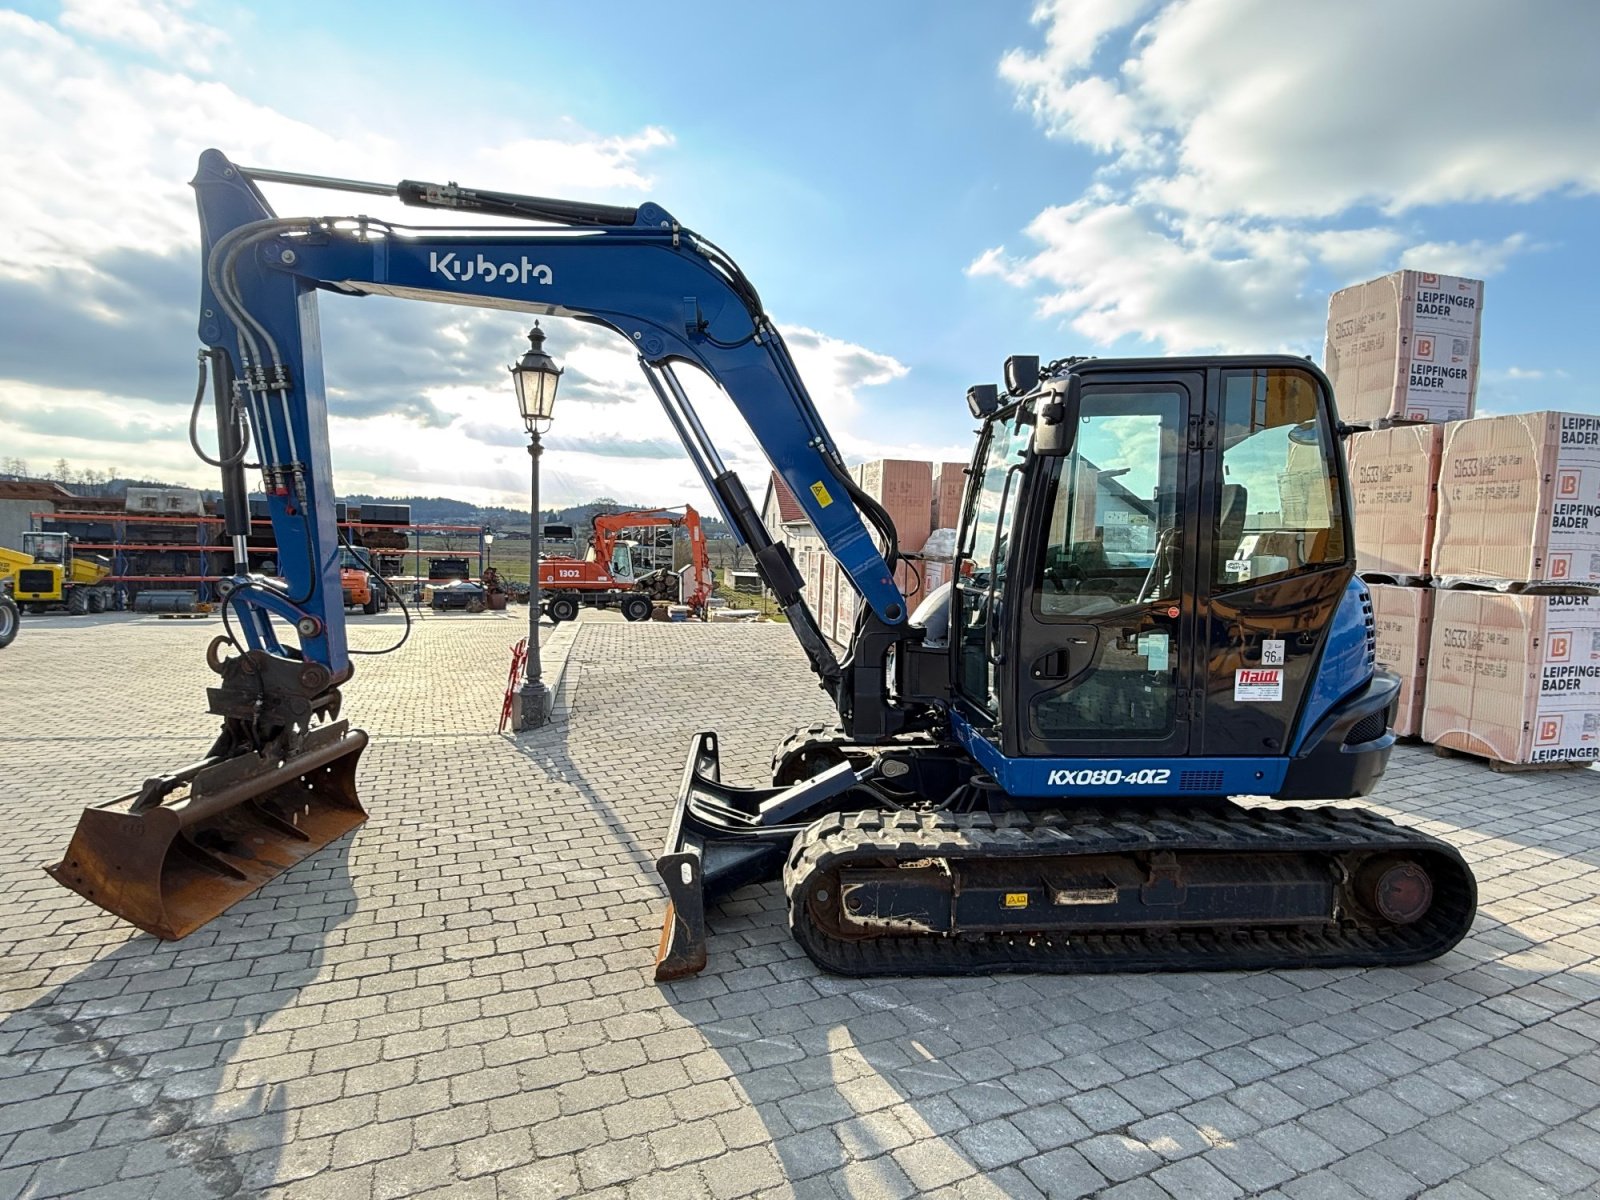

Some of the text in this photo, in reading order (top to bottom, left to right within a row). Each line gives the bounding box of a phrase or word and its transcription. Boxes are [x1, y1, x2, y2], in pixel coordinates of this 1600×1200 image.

[430, 252, 552, 285] Kubota
[1417, 291, 1475, 309] LEIPFINGER
[1416, 303, 1451, 316] BADER
[1411, 363, 1467, 380] LEIPFINGER
[1410, 375, 1444, 388] BADER
[1561, 431, 1598, 445] BADER
[1554, 503, 1600, 518] LEIPFING
[1552, 516, 1589, 529] BADER
[559, 569, 580, 577] 1302
[1549, 595, 1589, 606] BADER
[1264, 650, 1277, 663] 96
[1543, 665, 1600, 679] LEIPFINGE
[1541, 678, 1581, 691] BADER
[1531, 747, 1600, 760] LEIPFINGER
